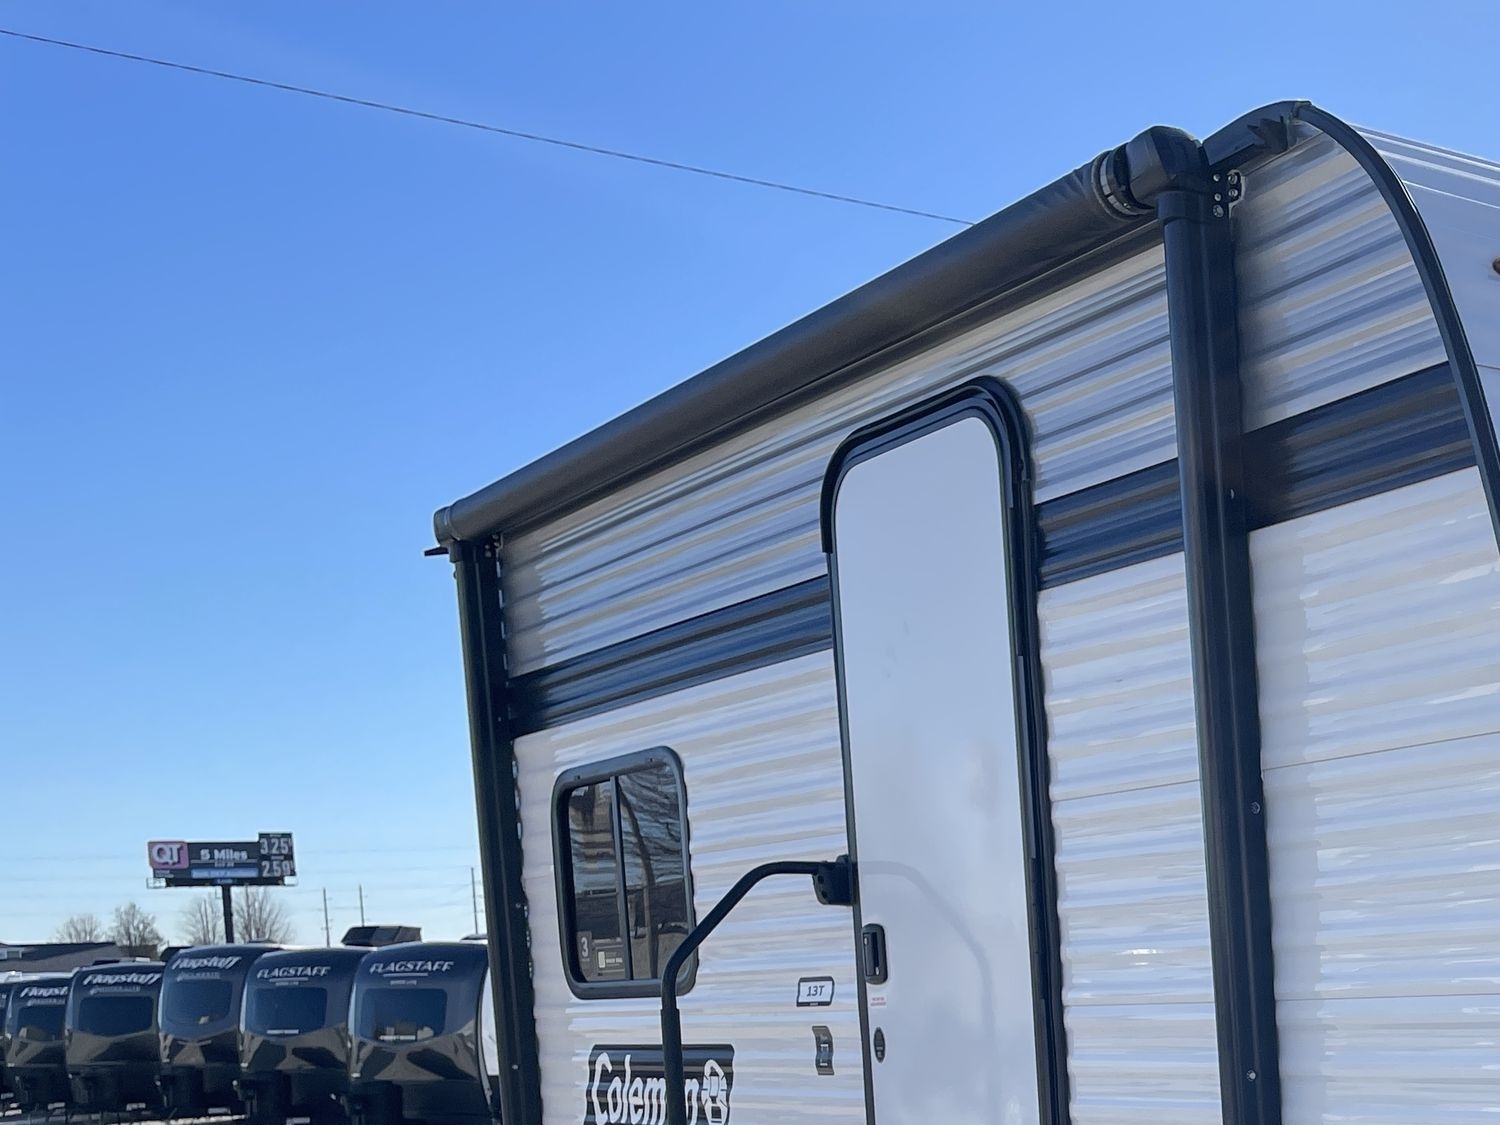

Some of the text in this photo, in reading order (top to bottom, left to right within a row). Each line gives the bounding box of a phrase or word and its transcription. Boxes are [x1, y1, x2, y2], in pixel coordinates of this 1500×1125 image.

[152, 844, 182, 865] QT
[214, 848, 248, 861] Miles
[581, 937, 589, 957] 3
[172, 956, 242, 970] Flagstaff
[369, 961, 454, 975] FLAGSTAFF
[83, 972, 161, 985] Flagstaff
[257, 966, 331, 978] FLAGSTAFF
[806, 985, 825, 997] 13T
